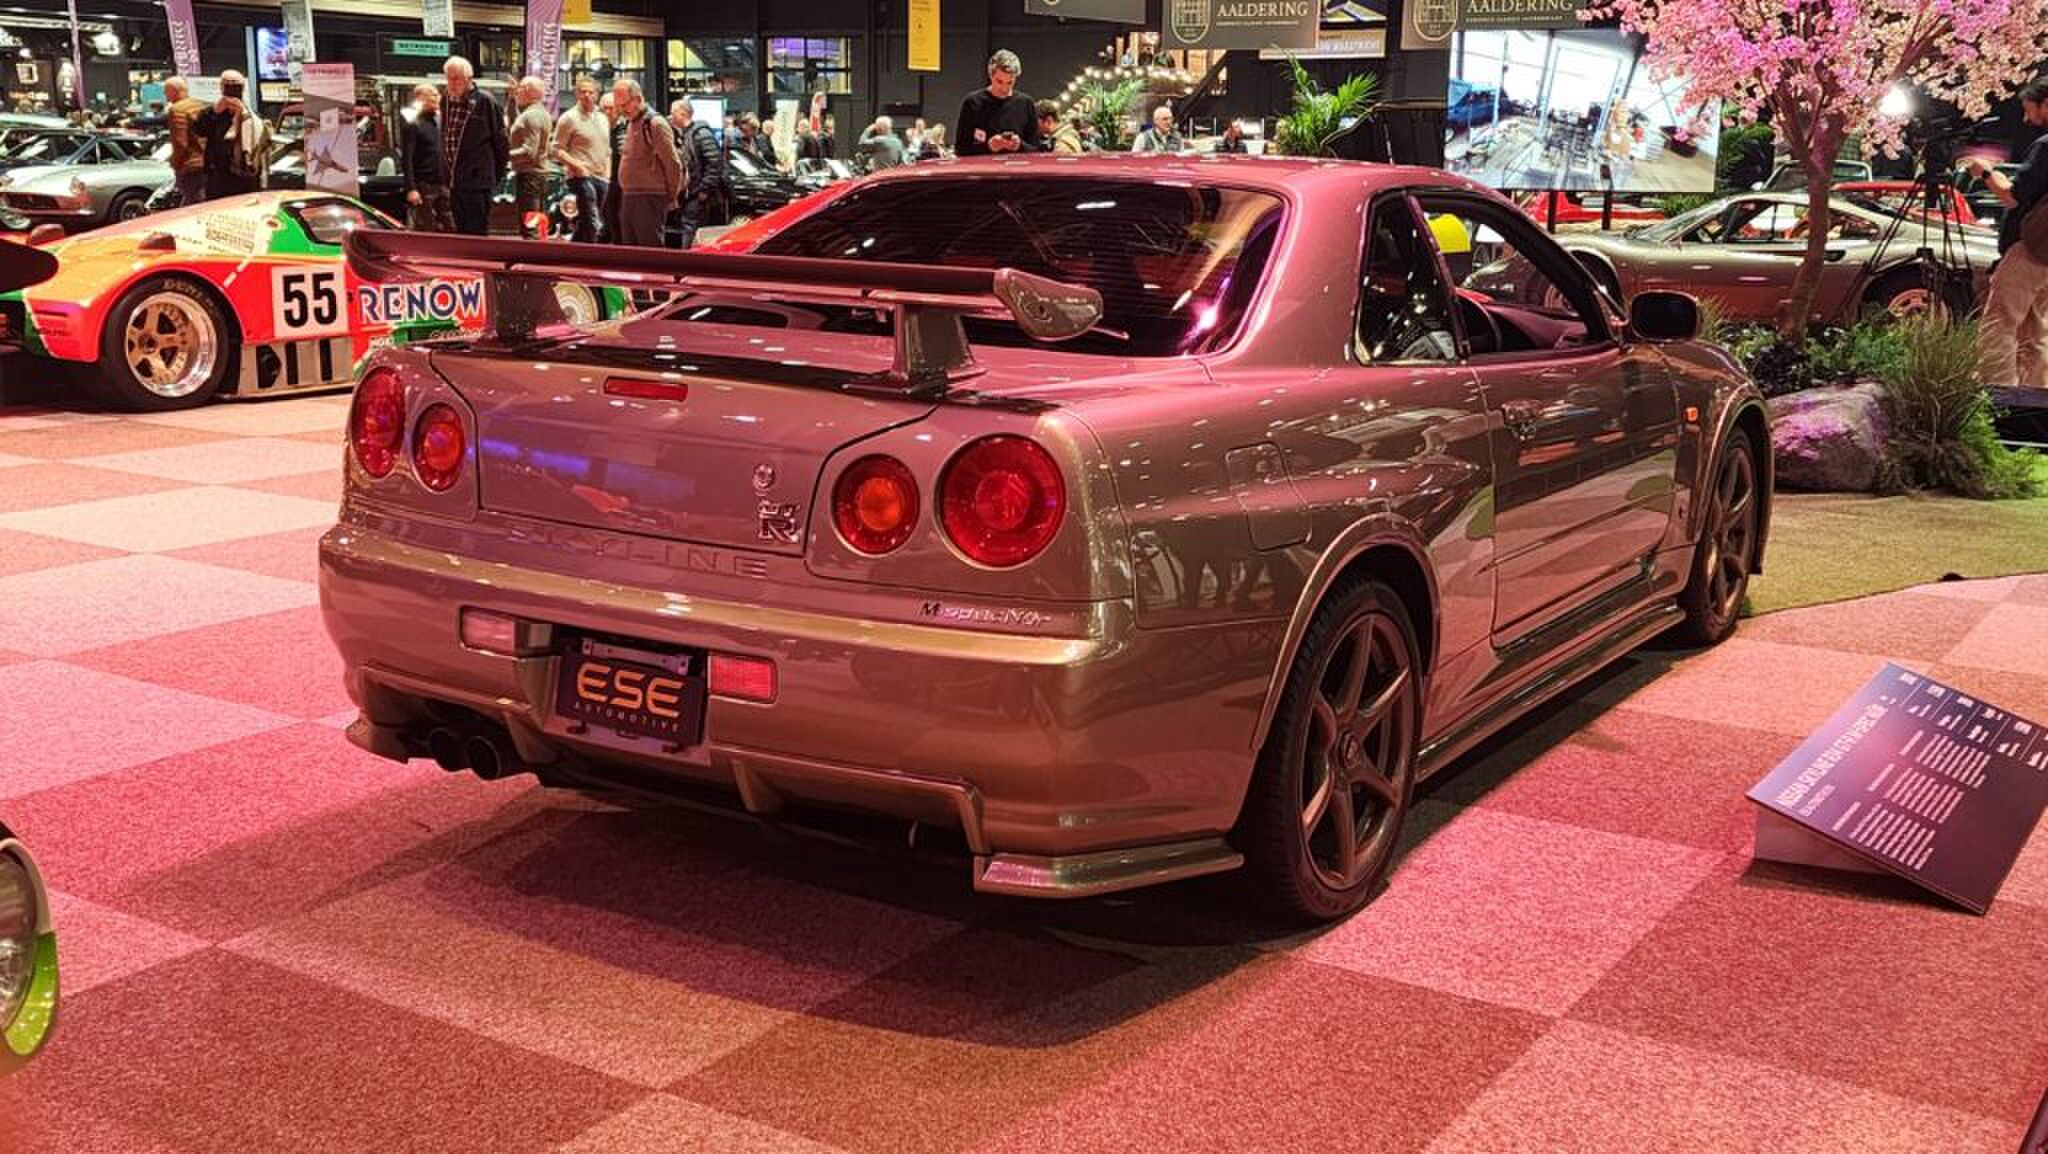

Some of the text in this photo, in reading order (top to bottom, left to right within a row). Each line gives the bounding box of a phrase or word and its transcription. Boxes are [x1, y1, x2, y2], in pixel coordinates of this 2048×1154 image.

[1217, 1, 1309, 17] AALDERING
[1466, 0, 1573, 13] AALDERING
[282, 270, 339, 330] 55
[358, 279, 483, 323] RENOW
[507, 519, 768, 580] SKYLINE
[577, 661, 685, 719] ESE
[574, 702, 679, 733] AUTOMOTIVE
